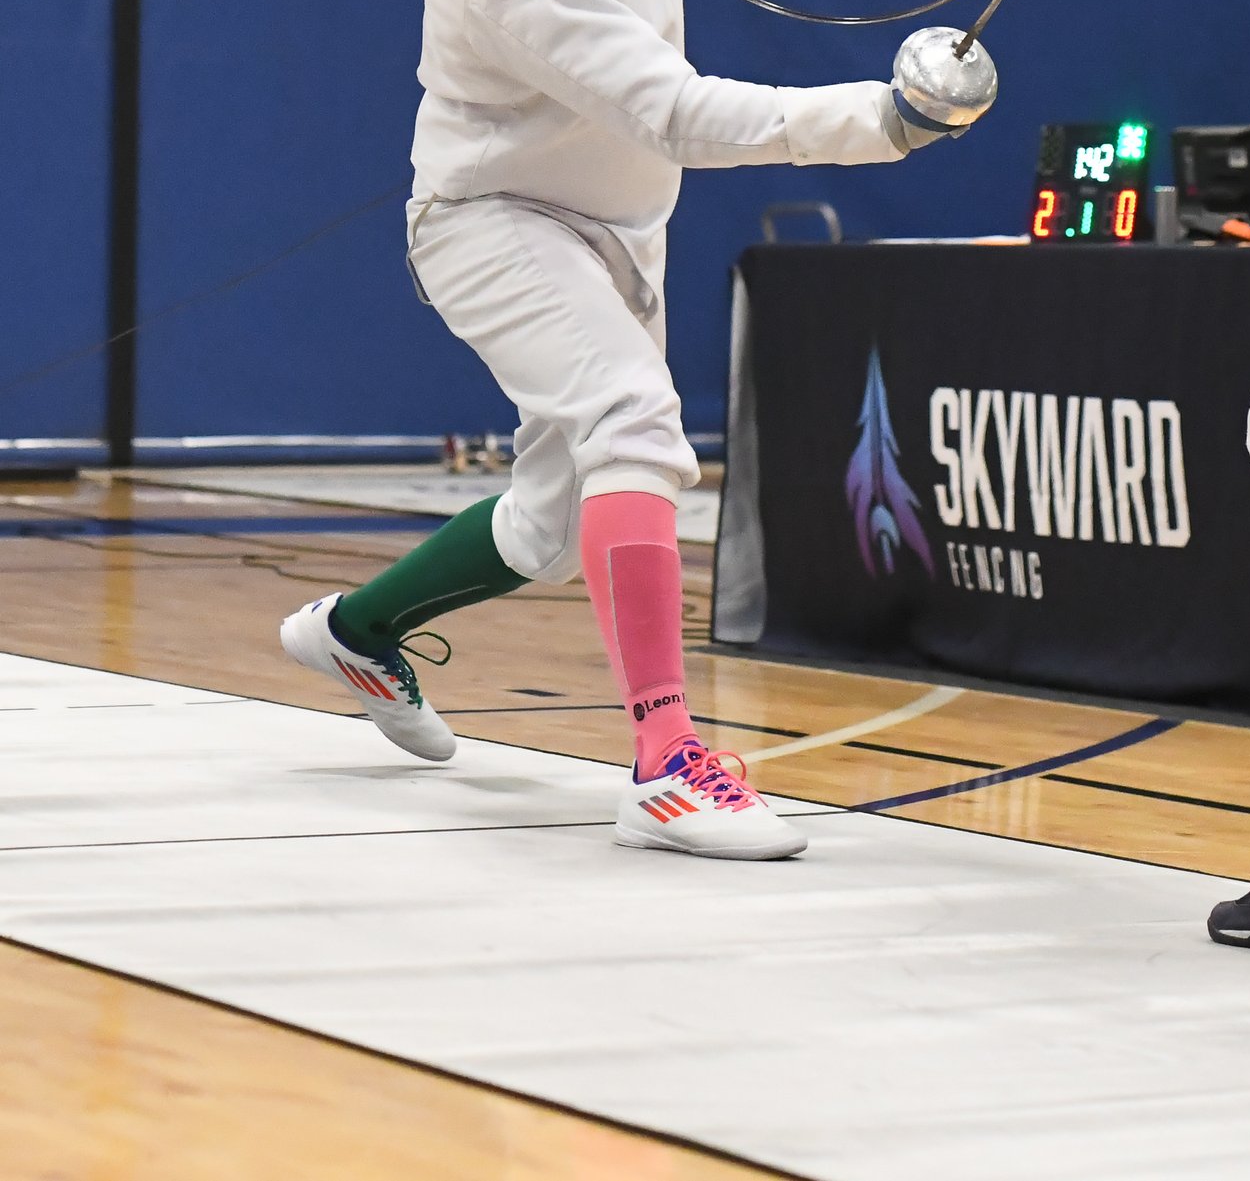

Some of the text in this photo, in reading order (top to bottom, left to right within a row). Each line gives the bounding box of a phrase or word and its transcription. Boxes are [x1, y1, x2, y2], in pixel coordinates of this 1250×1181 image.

[1033, 189, 1056, 238] 2
[1113, 189, 1137, 238] 0
[929, 386, 1191, 548] SKYWARD
[946, 541, 1044, 600] FENCNG
[643, 692, 681, 712] Leon
